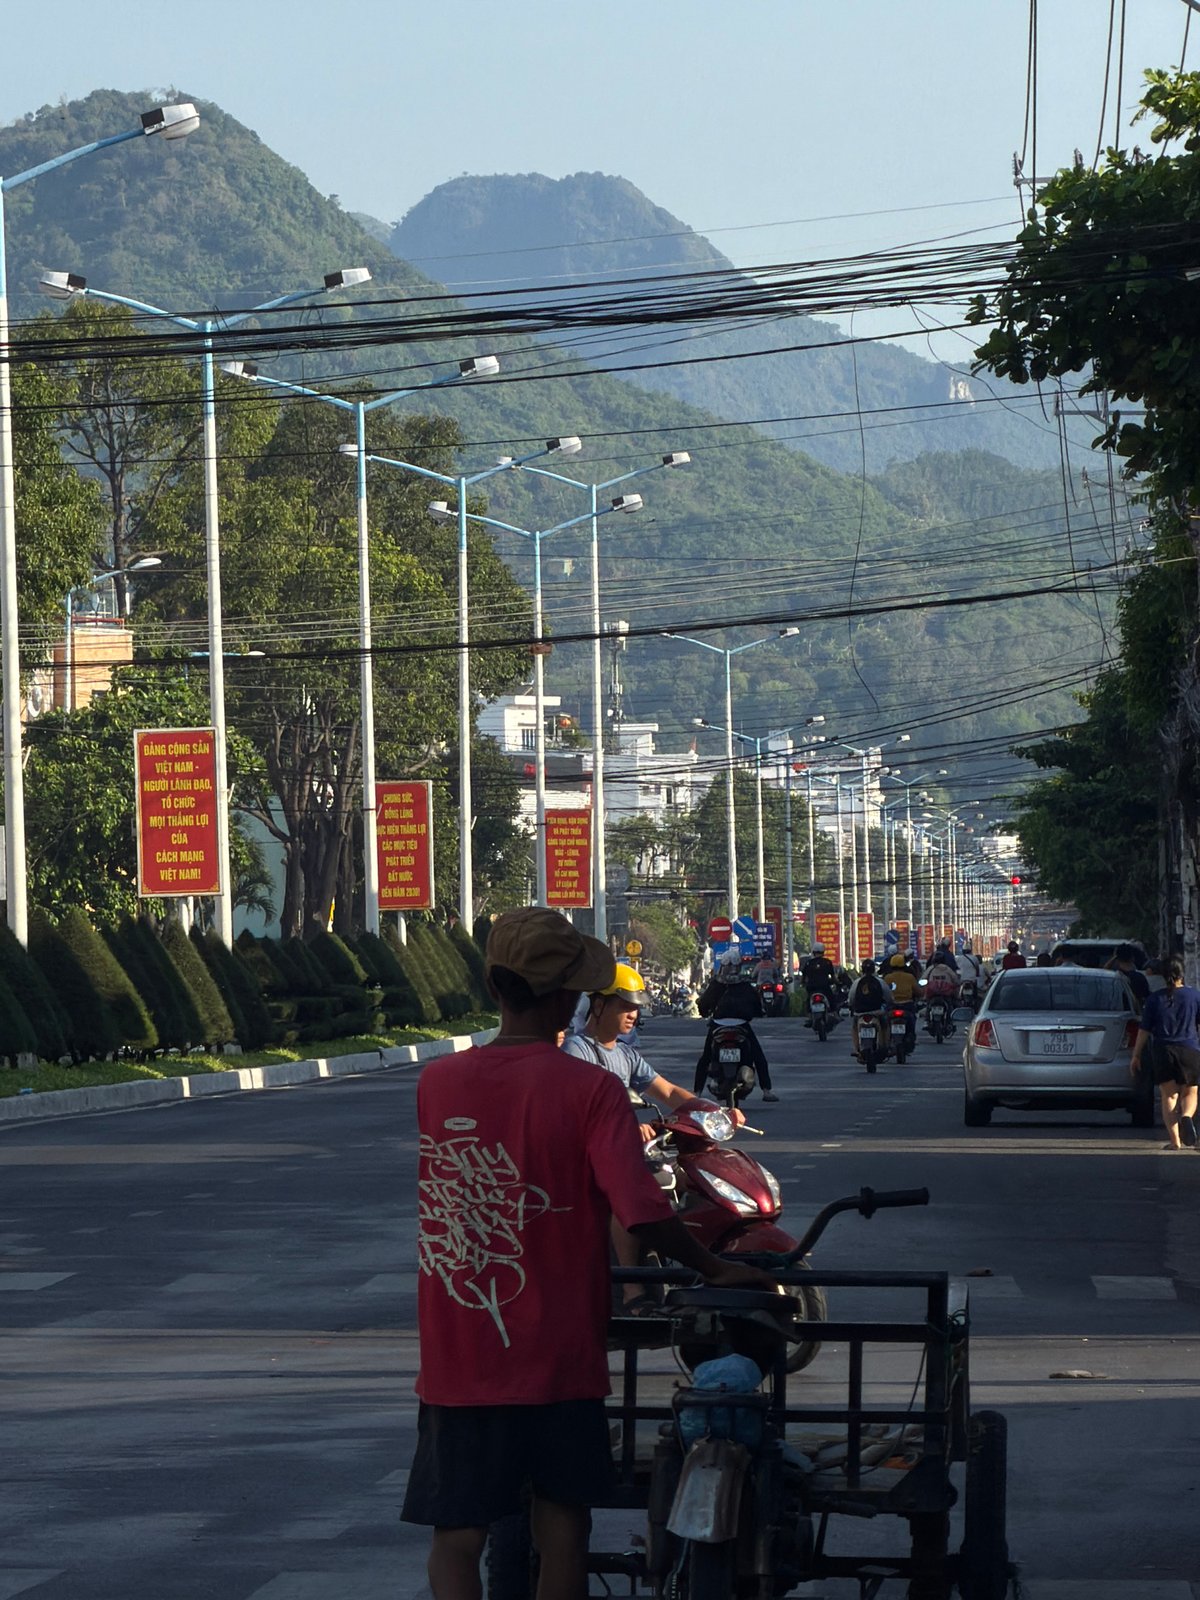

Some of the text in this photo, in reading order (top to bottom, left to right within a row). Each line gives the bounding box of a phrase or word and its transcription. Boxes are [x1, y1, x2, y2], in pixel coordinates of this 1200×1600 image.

[144, 740, 210, 758] ĐẢNG CỘNG SẢN
[155, 760, 172, 776] VIỆT
[174, 762, 194, 772] NAM
[144, 778, 212, 792] NGƯỜI LÃNH ĐẠO,
[162, 794, 196, 808] TỔ CHỨC
[150, 811, 208, 829] MỌI THẮNG LỢI
[172, 830, 188, 844] CỦA
[156, 850, 204, 864] CÁCH MẠNG
[160, 868, 200, 882] VIỆT NAM!
